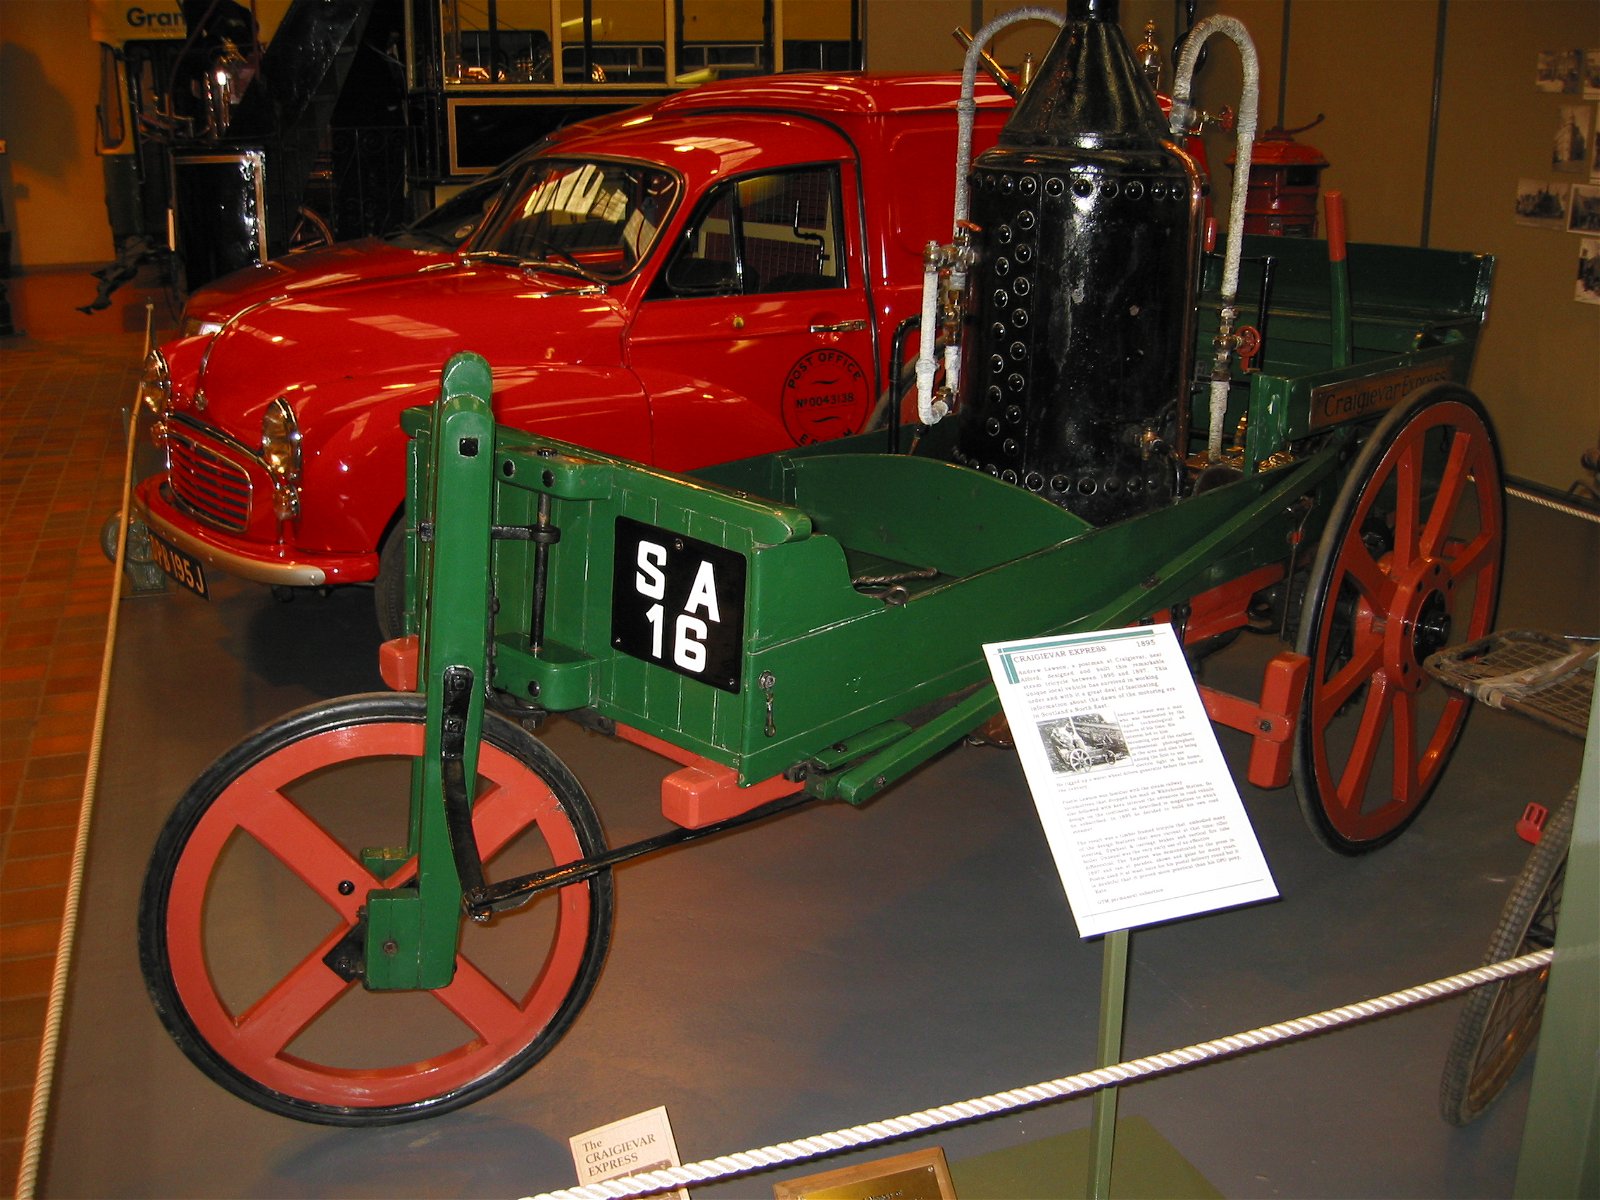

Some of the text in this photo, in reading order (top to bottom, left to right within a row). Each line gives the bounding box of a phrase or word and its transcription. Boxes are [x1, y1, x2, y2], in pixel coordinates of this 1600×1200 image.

[788, 352, 861, 389] POST OFFICE
[646, 603, 708, 673] 16
[1136, 639, 1156, 647] 1895
[1013, 645, 1106, 663] CRAIGIEVAR EXPRESS
[1132, 659, 1164, 667] remarkable
[1078, 660, 1104, 668] postman
[582, 1138, 602, 1152] The
[585, 1133, 656, 1164] CRAIGIEVAR
[588, 1152, 639, 1177] EXPRESS
